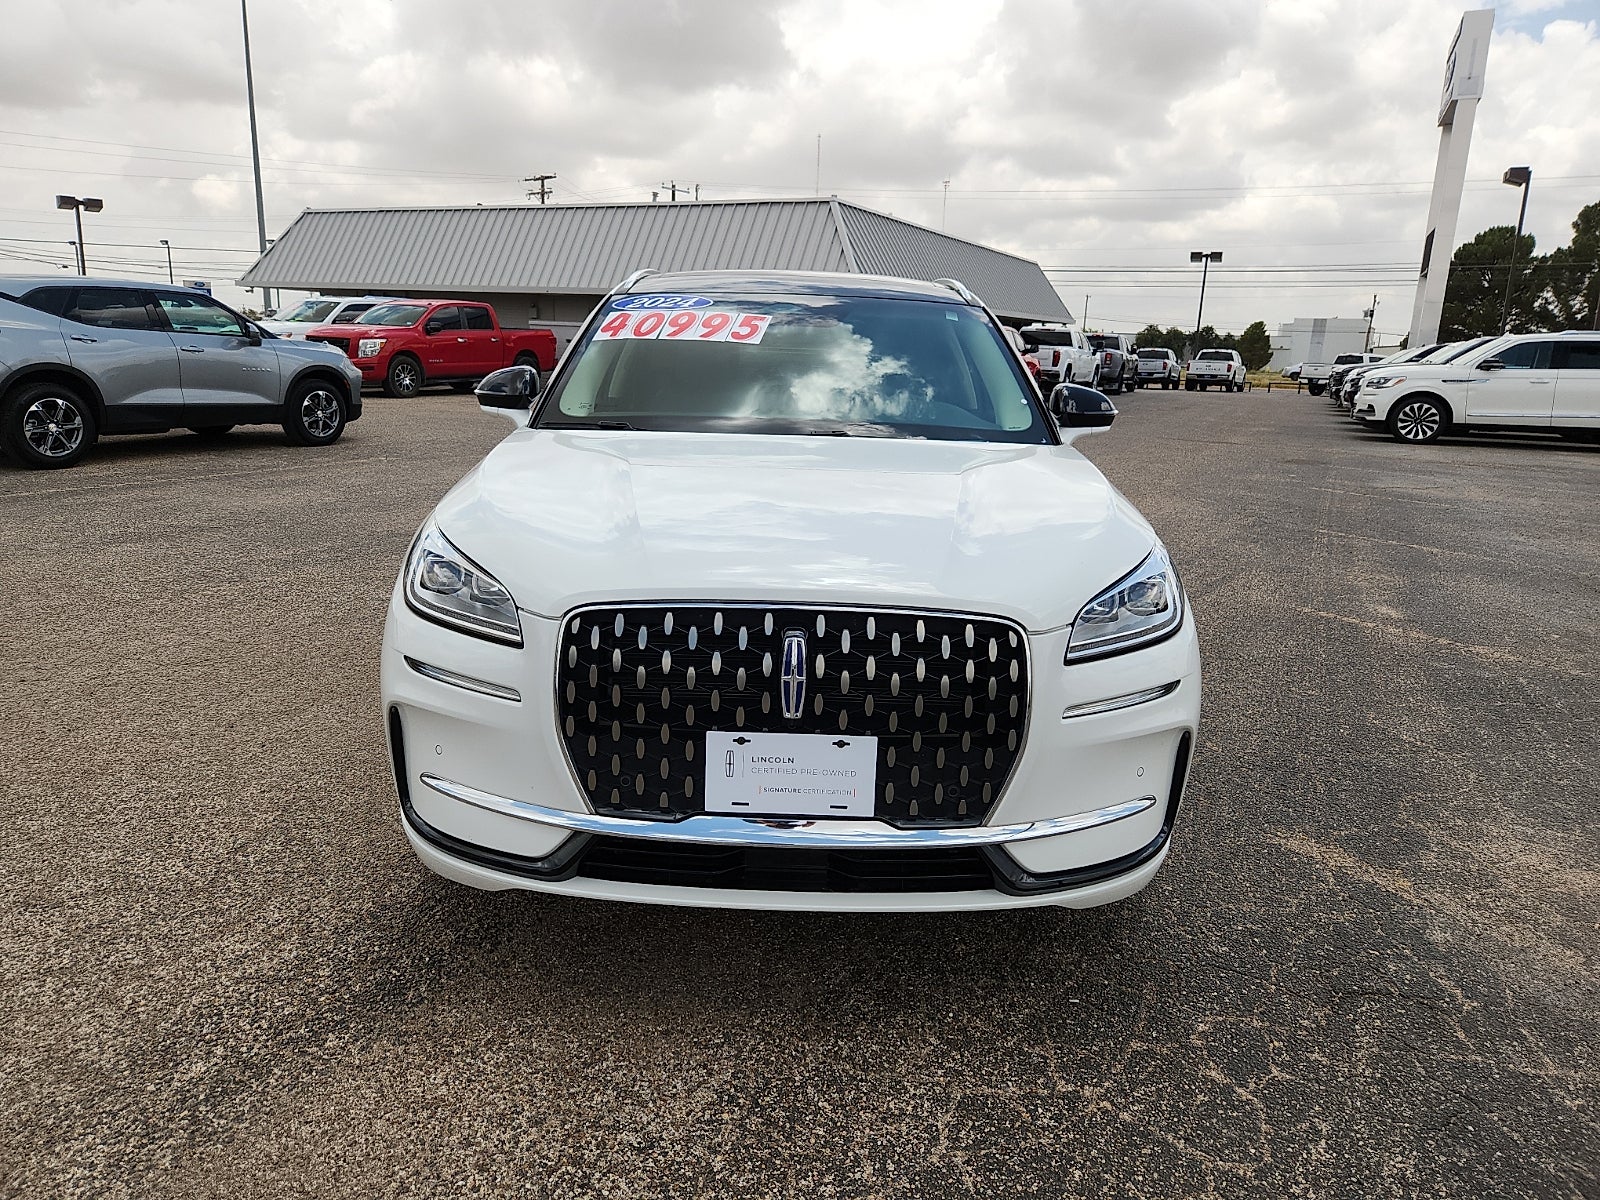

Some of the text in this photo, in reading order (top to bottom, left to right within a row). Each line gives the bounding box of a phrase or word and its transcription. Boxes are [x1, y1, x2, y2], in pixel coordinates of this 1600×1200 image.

[627, 296, 695, 309] 2024
[600, 311, 767, 341] 40995
[751, 756, 795, 764] LINCOLN
[751, 767, 857, 777] CERTIFIED PRE-OWNED
[803, 788, 852, 796] CERTIFICATION
